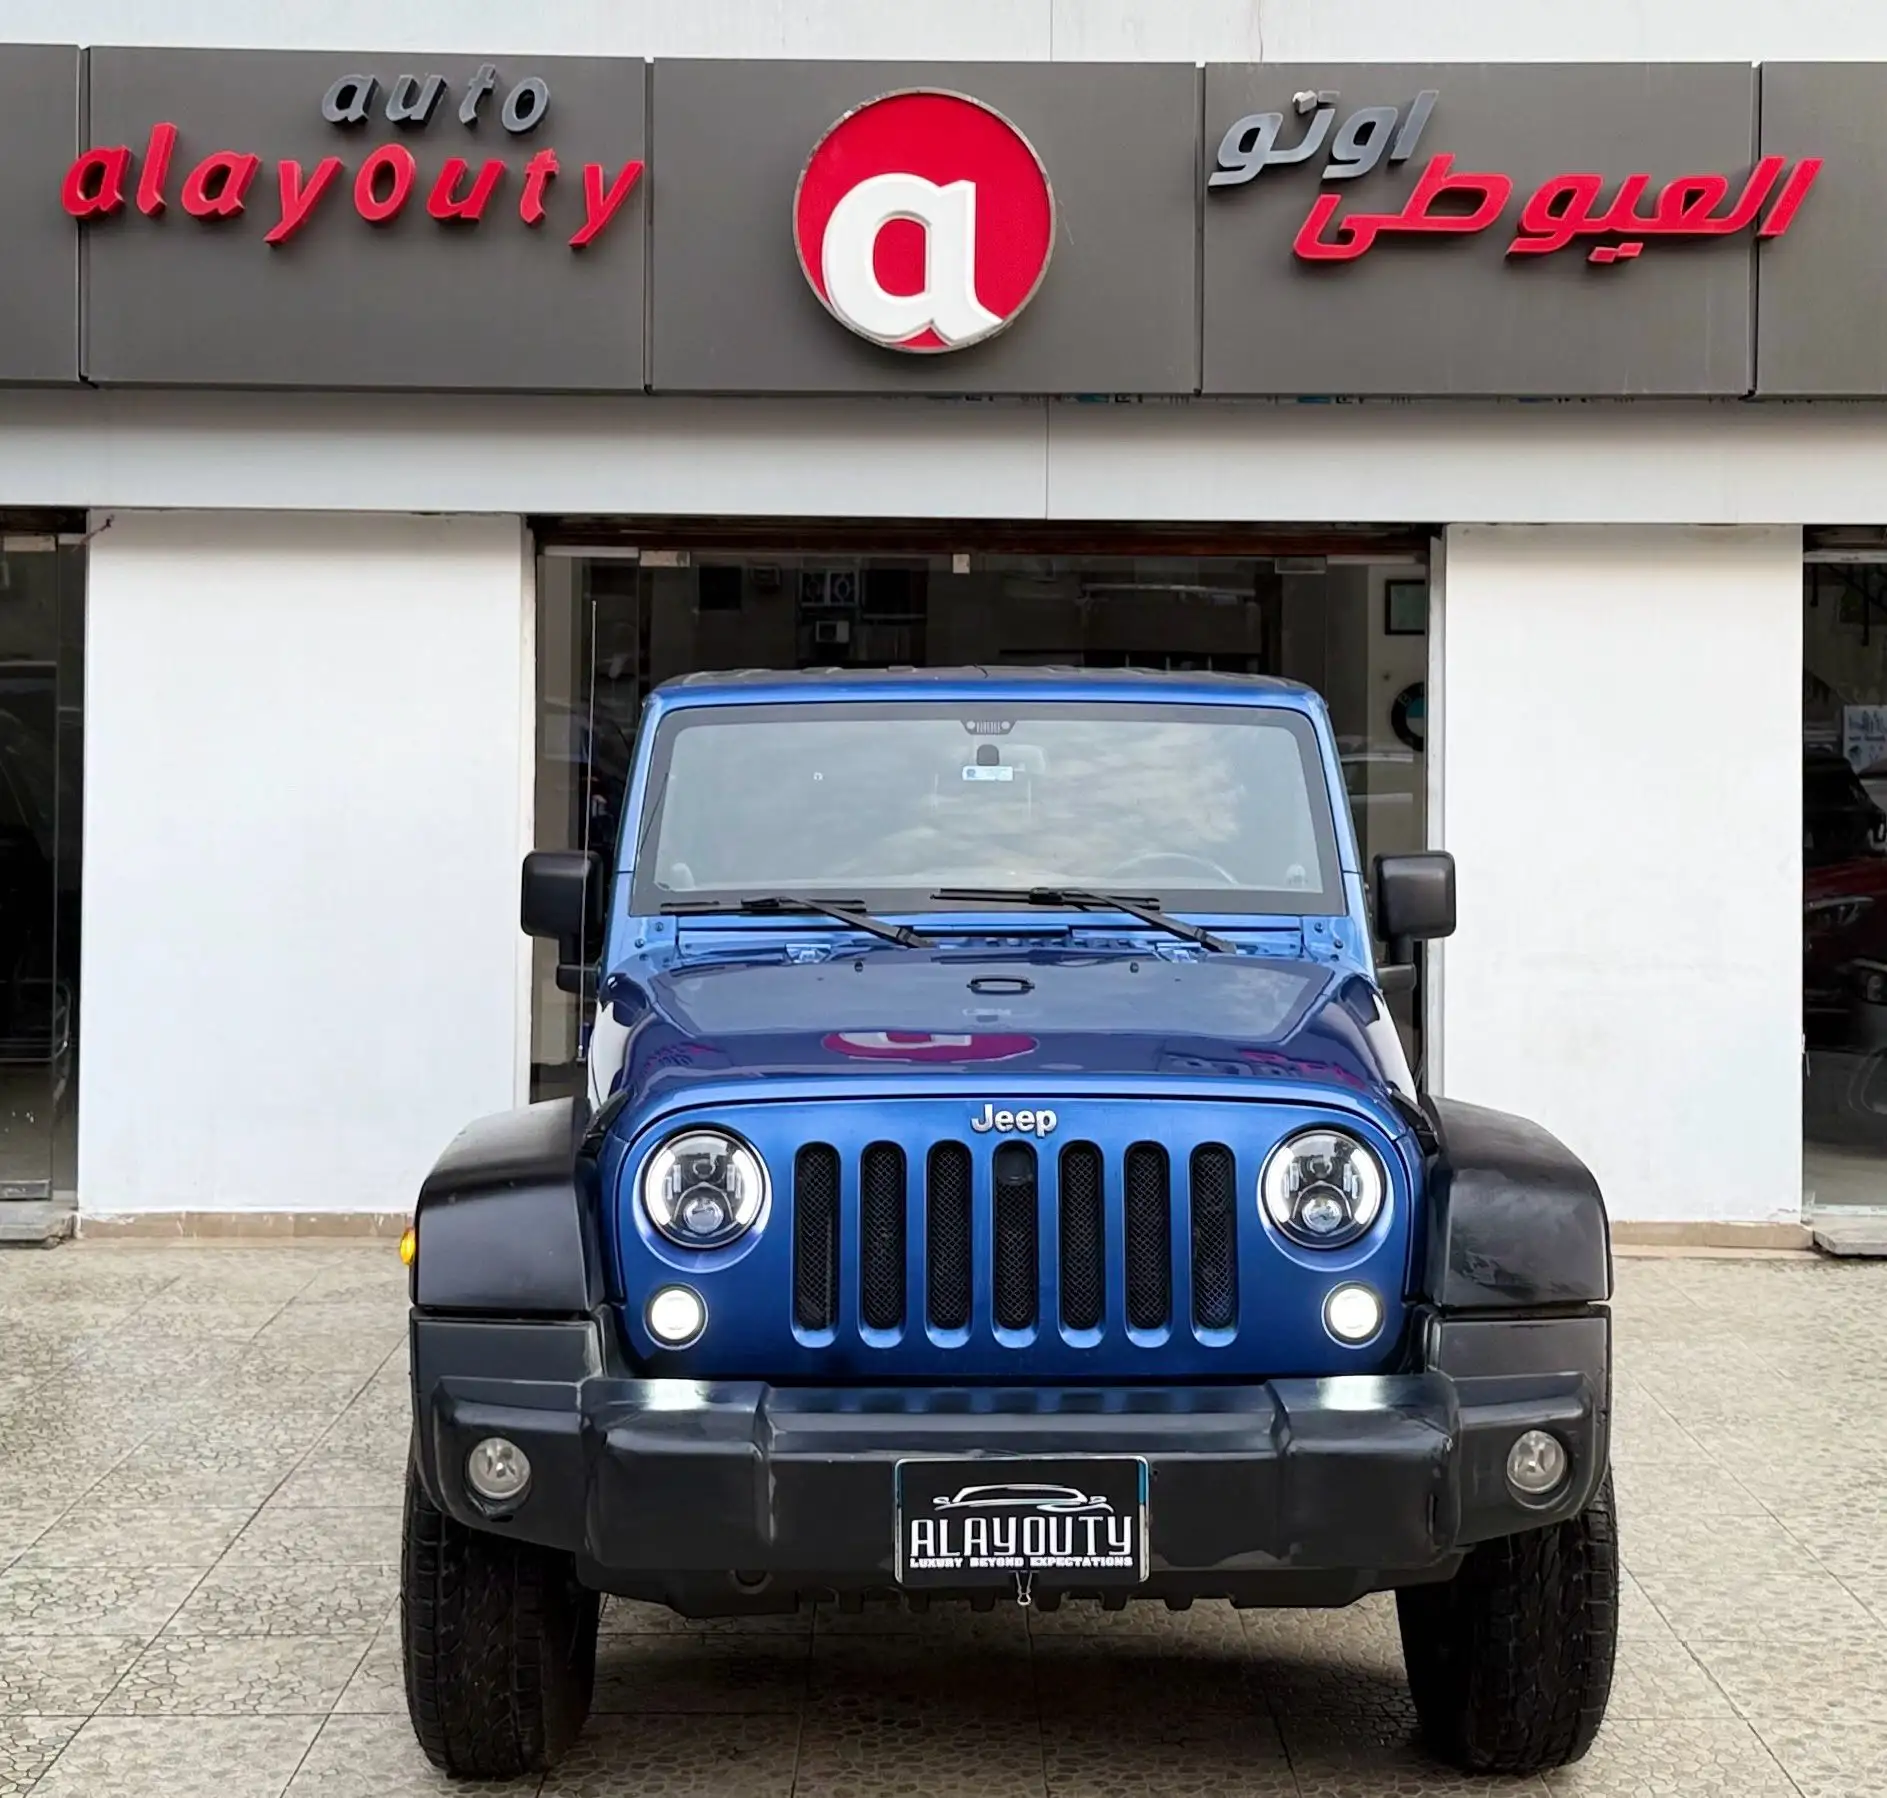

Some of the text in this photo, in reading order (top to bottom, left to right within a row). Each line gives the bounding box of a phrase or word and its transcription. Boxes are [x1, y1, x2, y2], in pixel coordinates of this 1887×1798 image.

[321, 63, 550, 134] auto
[821, 171, 1004, 346] a
[970, 1103, 1057, 1138] Jeep
[910, 1516, 1132, 1558] ALAYOUTY
[910, 1556, 1133, 1568] LUXURY BEYOND EXPECTATIONS
